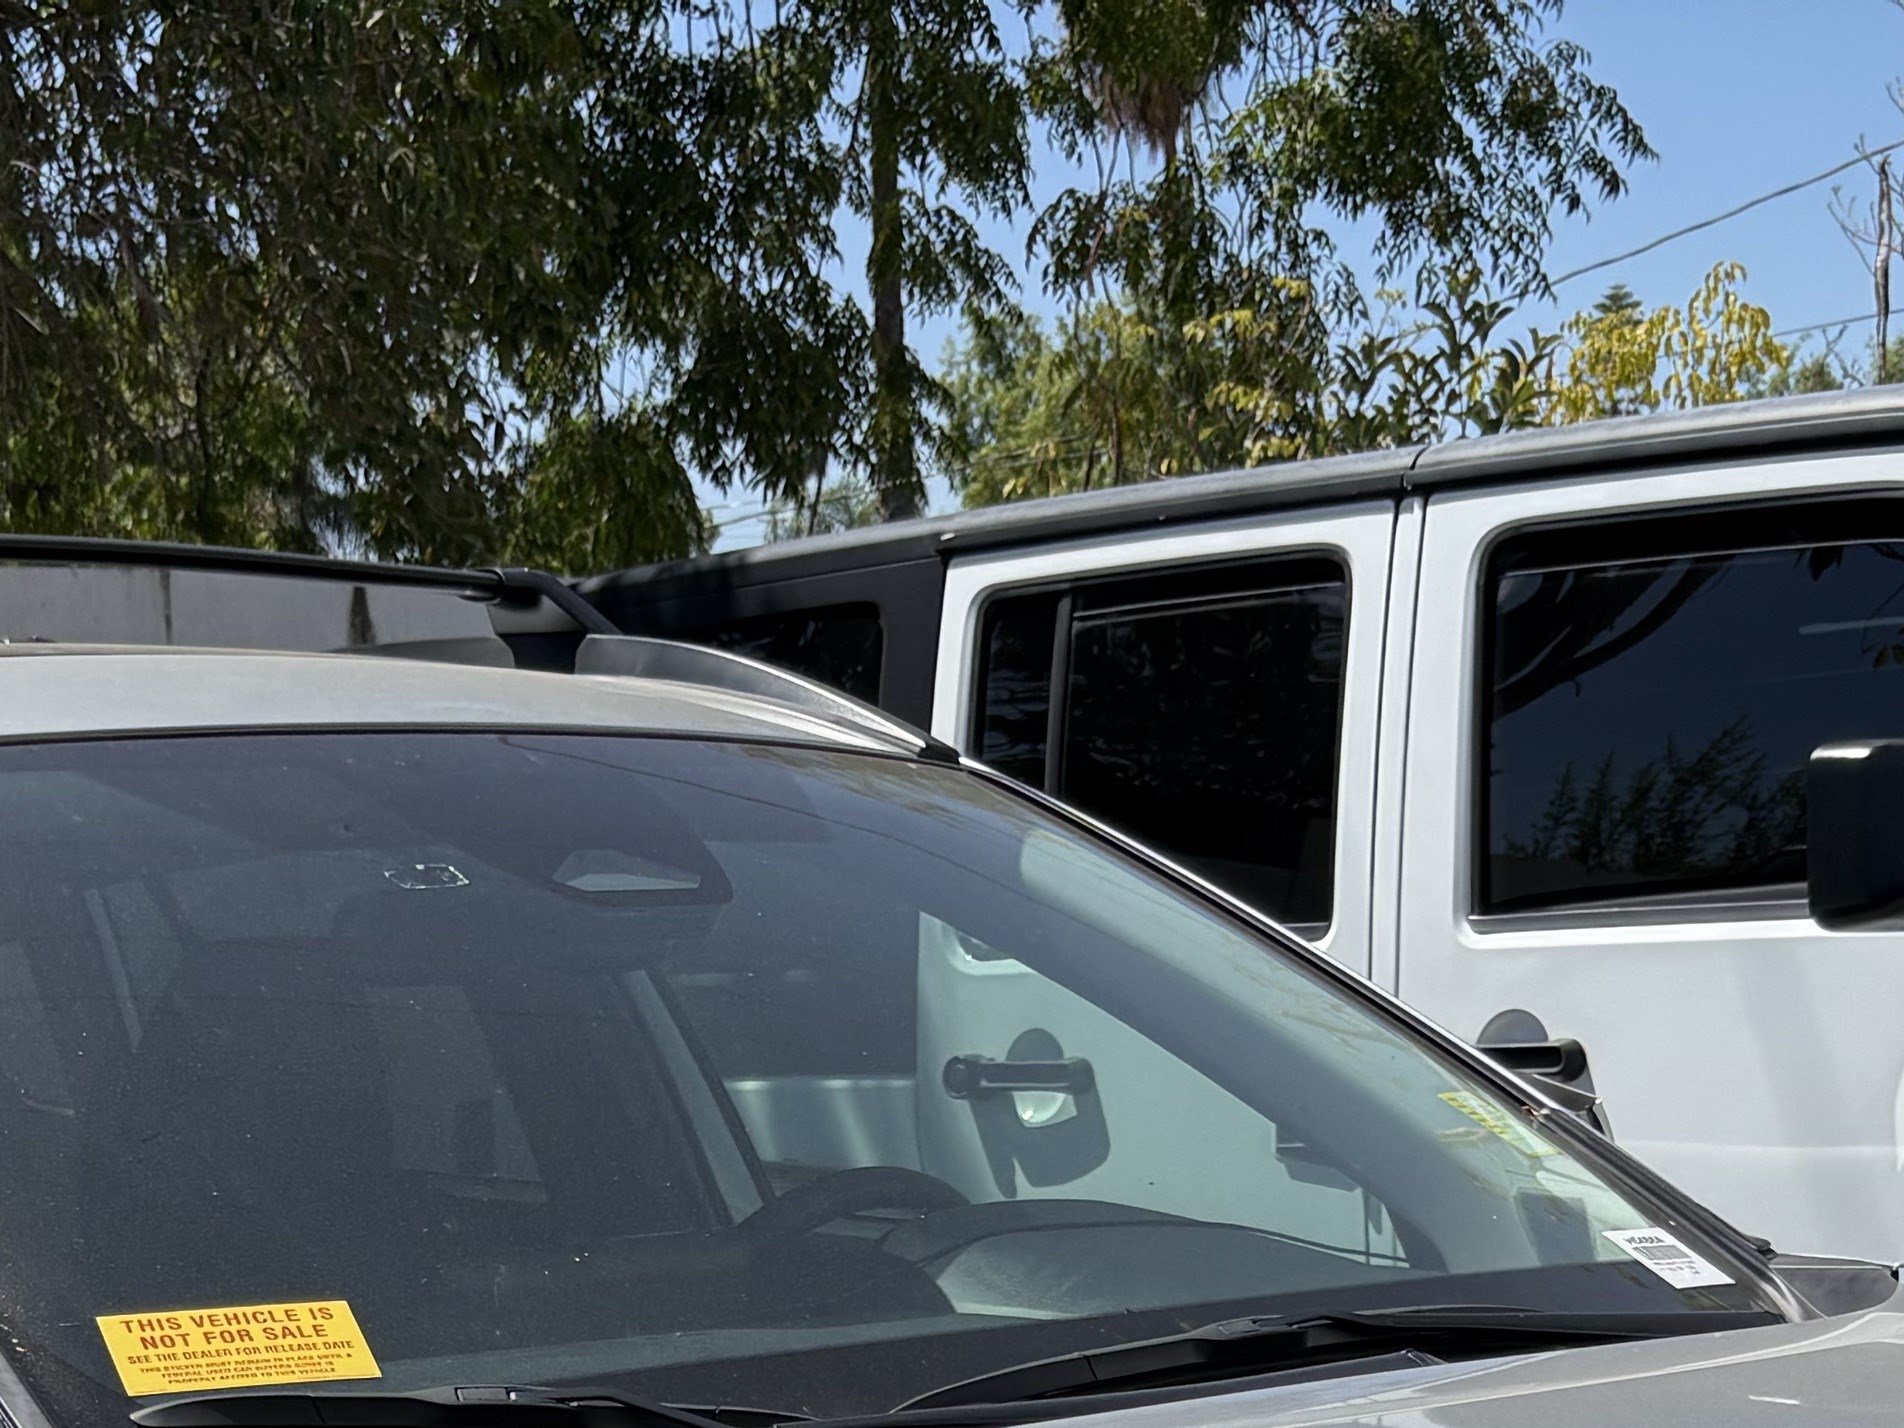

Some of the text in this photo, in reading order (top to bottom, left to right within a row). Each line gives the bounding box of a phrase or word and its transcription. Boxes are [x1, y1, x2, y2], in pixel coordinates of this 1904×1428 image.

[119, 1307, 334, 1333] THIS VEHICLE IS
[139, 1323, 328, 1350] NOT FOR SALE
[127, 1340, 354, 1365] SEE THE DEALER FOR RELEASE DATE
